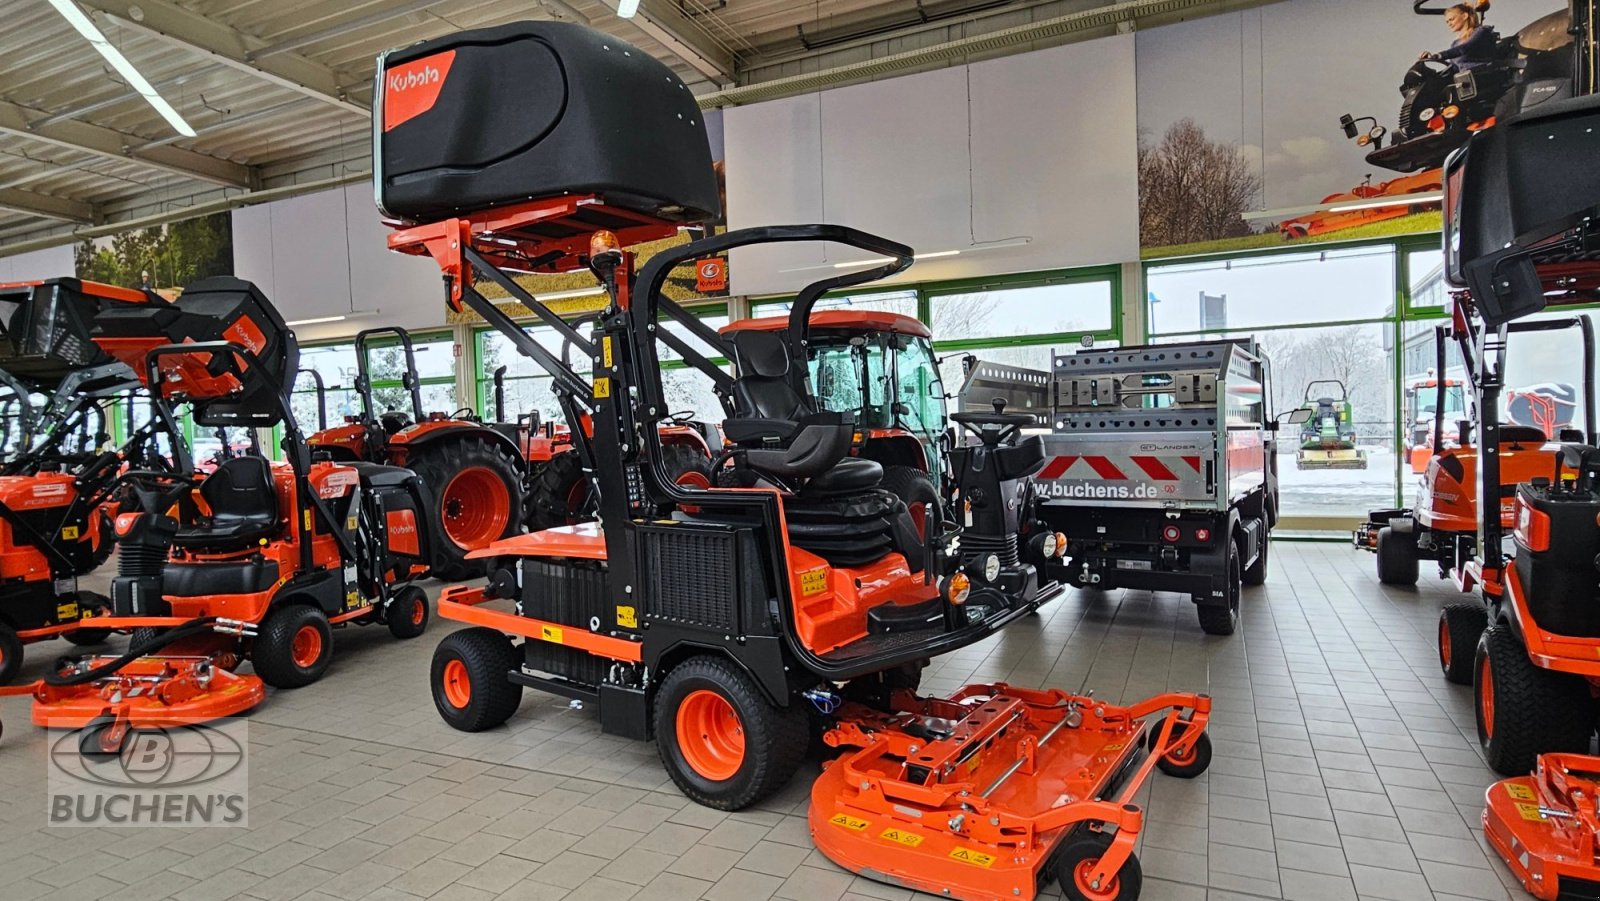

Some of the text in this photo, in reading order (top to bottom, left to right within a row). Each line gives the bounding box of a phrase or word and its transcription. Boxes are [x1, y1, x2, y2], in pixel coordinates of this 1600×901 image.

[390, 65, 439, 92] Kubota
[235, 324, 257, 352] Kubota
[390, 525, 415, 535] Kubota
